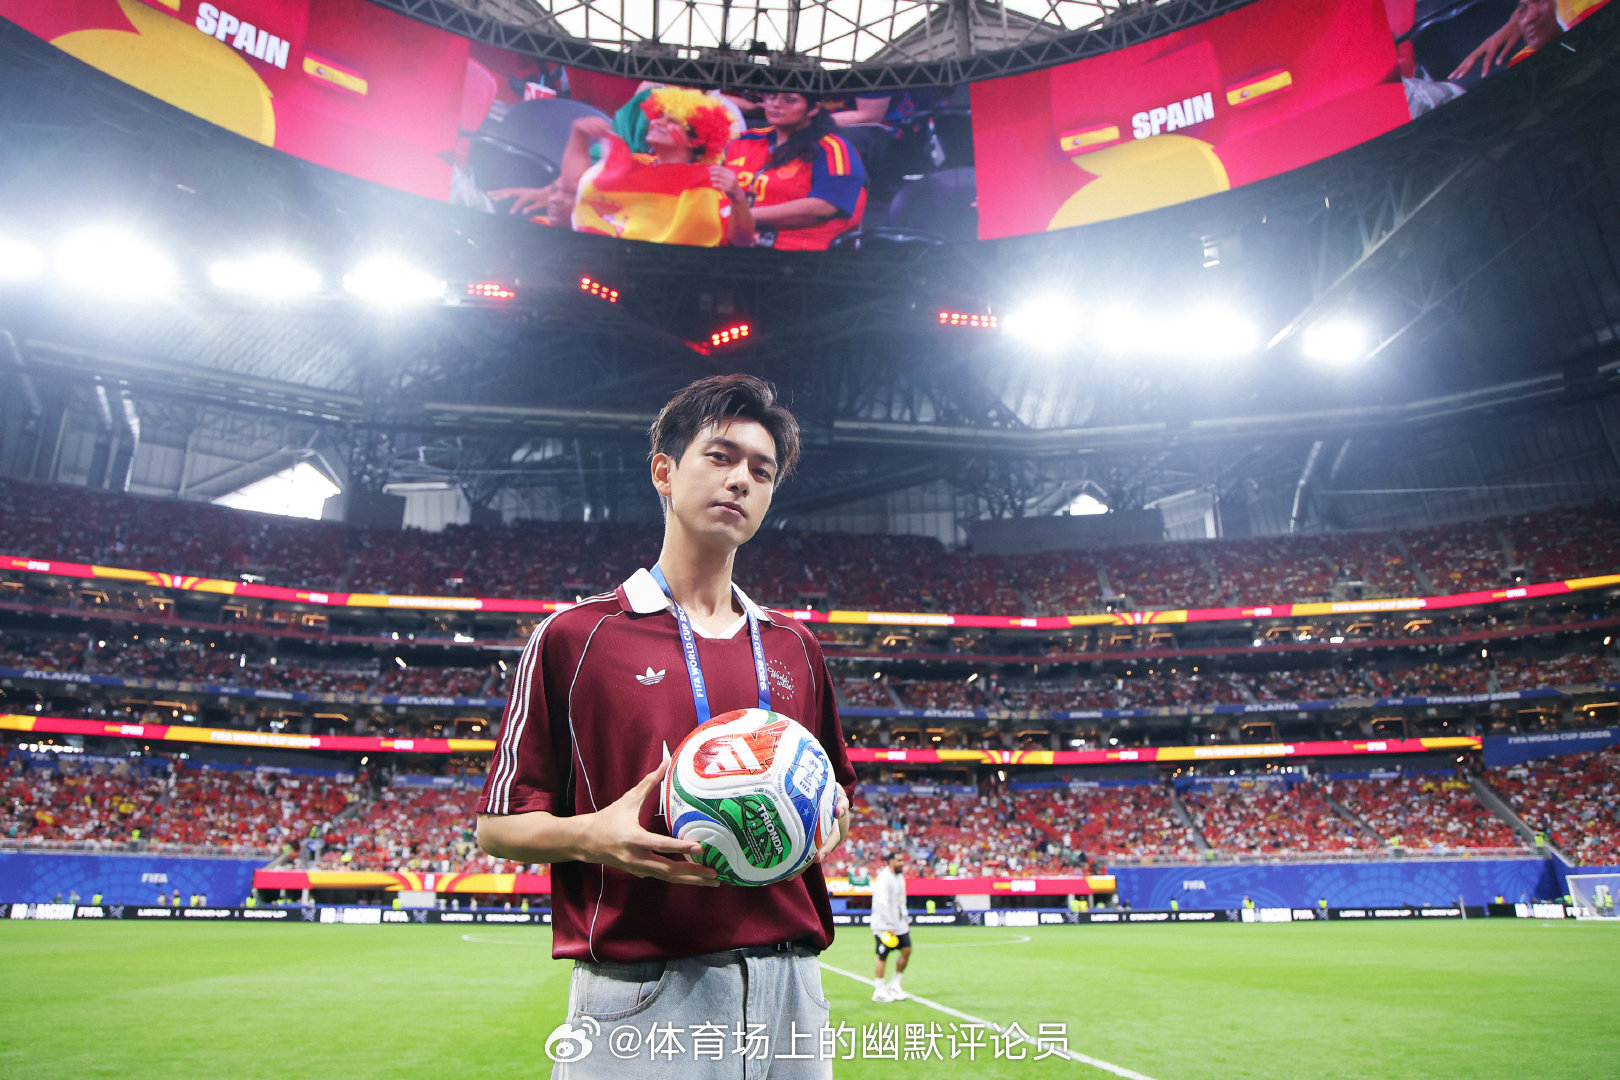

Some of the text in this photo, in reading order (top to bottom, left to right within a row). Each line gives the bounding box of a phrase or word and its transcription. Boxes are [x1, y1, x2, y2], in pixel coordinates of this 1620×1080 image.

[195, 2, 290, 70] SPAIN
[1132, 91, 1215, 139] SPAIN
[681, 623, 692, 641] CUP
[685, 642, 700, 676] WORLD
[23, 670, 91, 683] ATLANTA
[692, 677, 704, 698] FIFA
[757, 803, 785, 855] TRIONDA
[141, 872, 168, 883] FIFA
